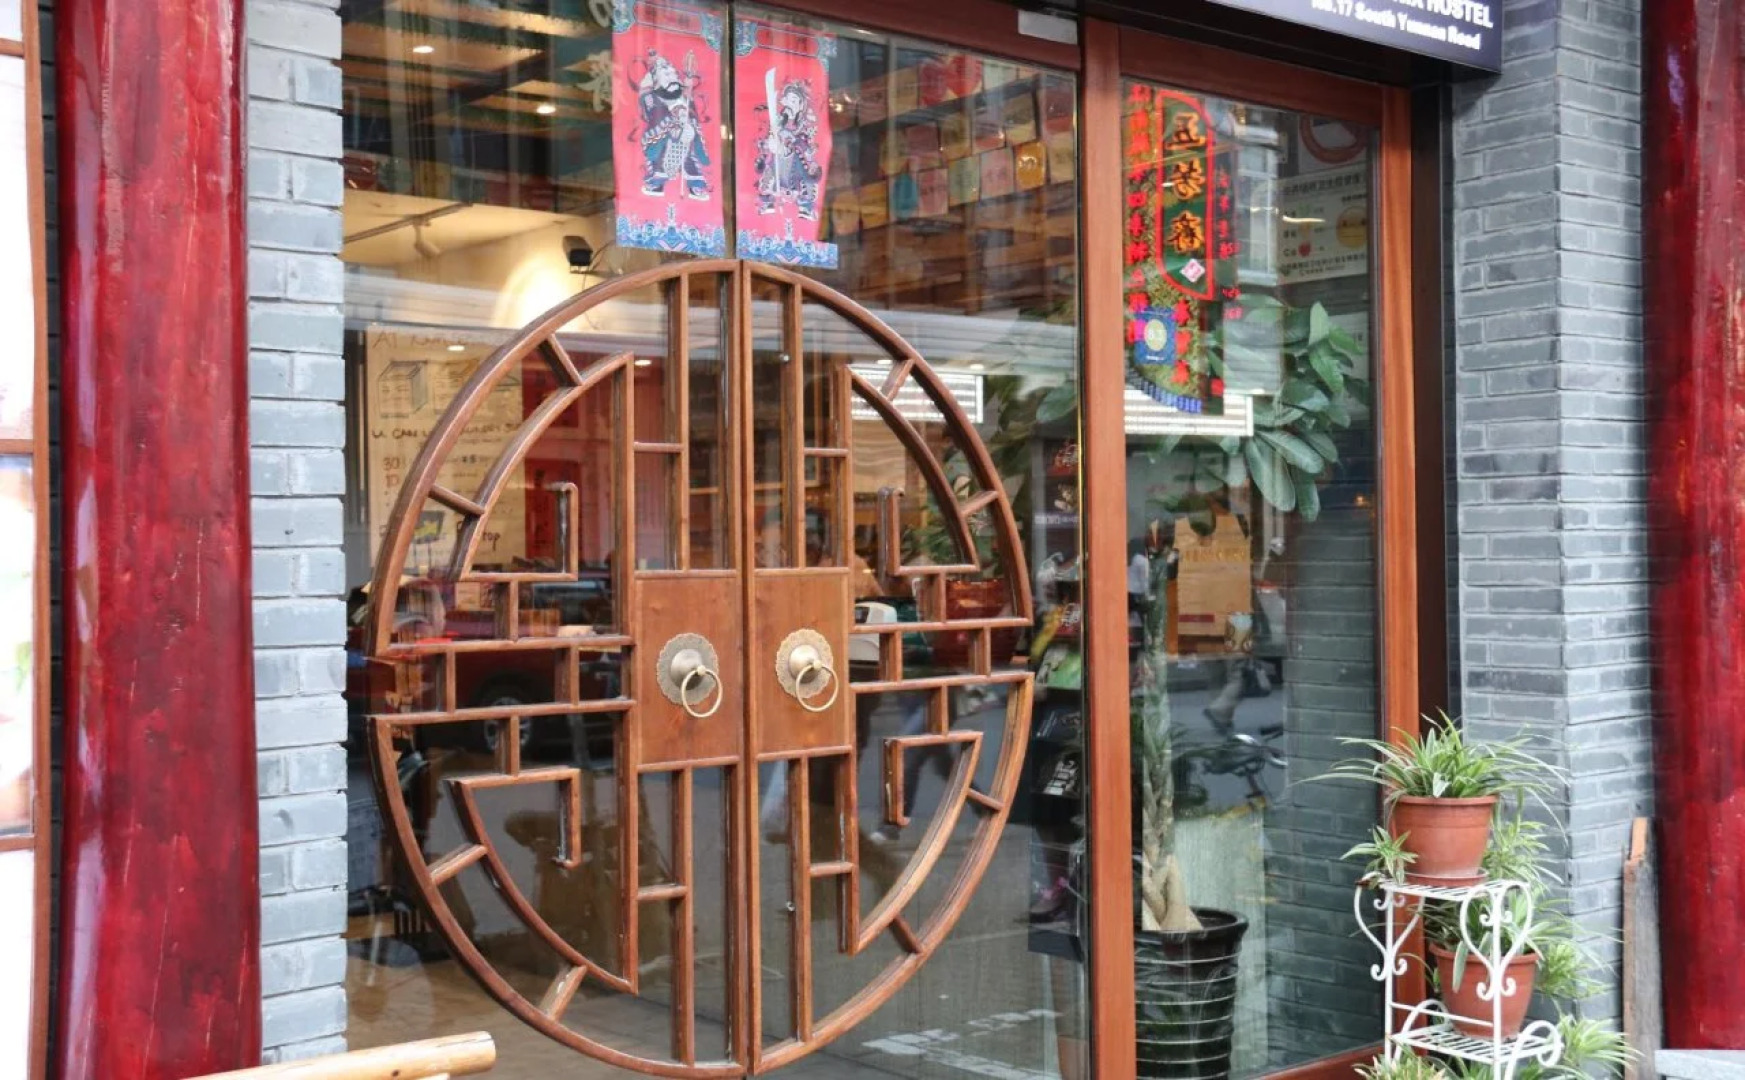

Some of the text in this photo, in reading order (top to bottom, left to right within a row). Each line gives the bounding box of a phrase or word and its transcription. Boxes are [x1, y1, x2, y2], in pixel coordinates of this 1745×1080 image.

[1354, 1, 1396, 28] South
[1447, 25, 1481, 51] Road
[1426, 0, 1494, 28] HOSTEL
